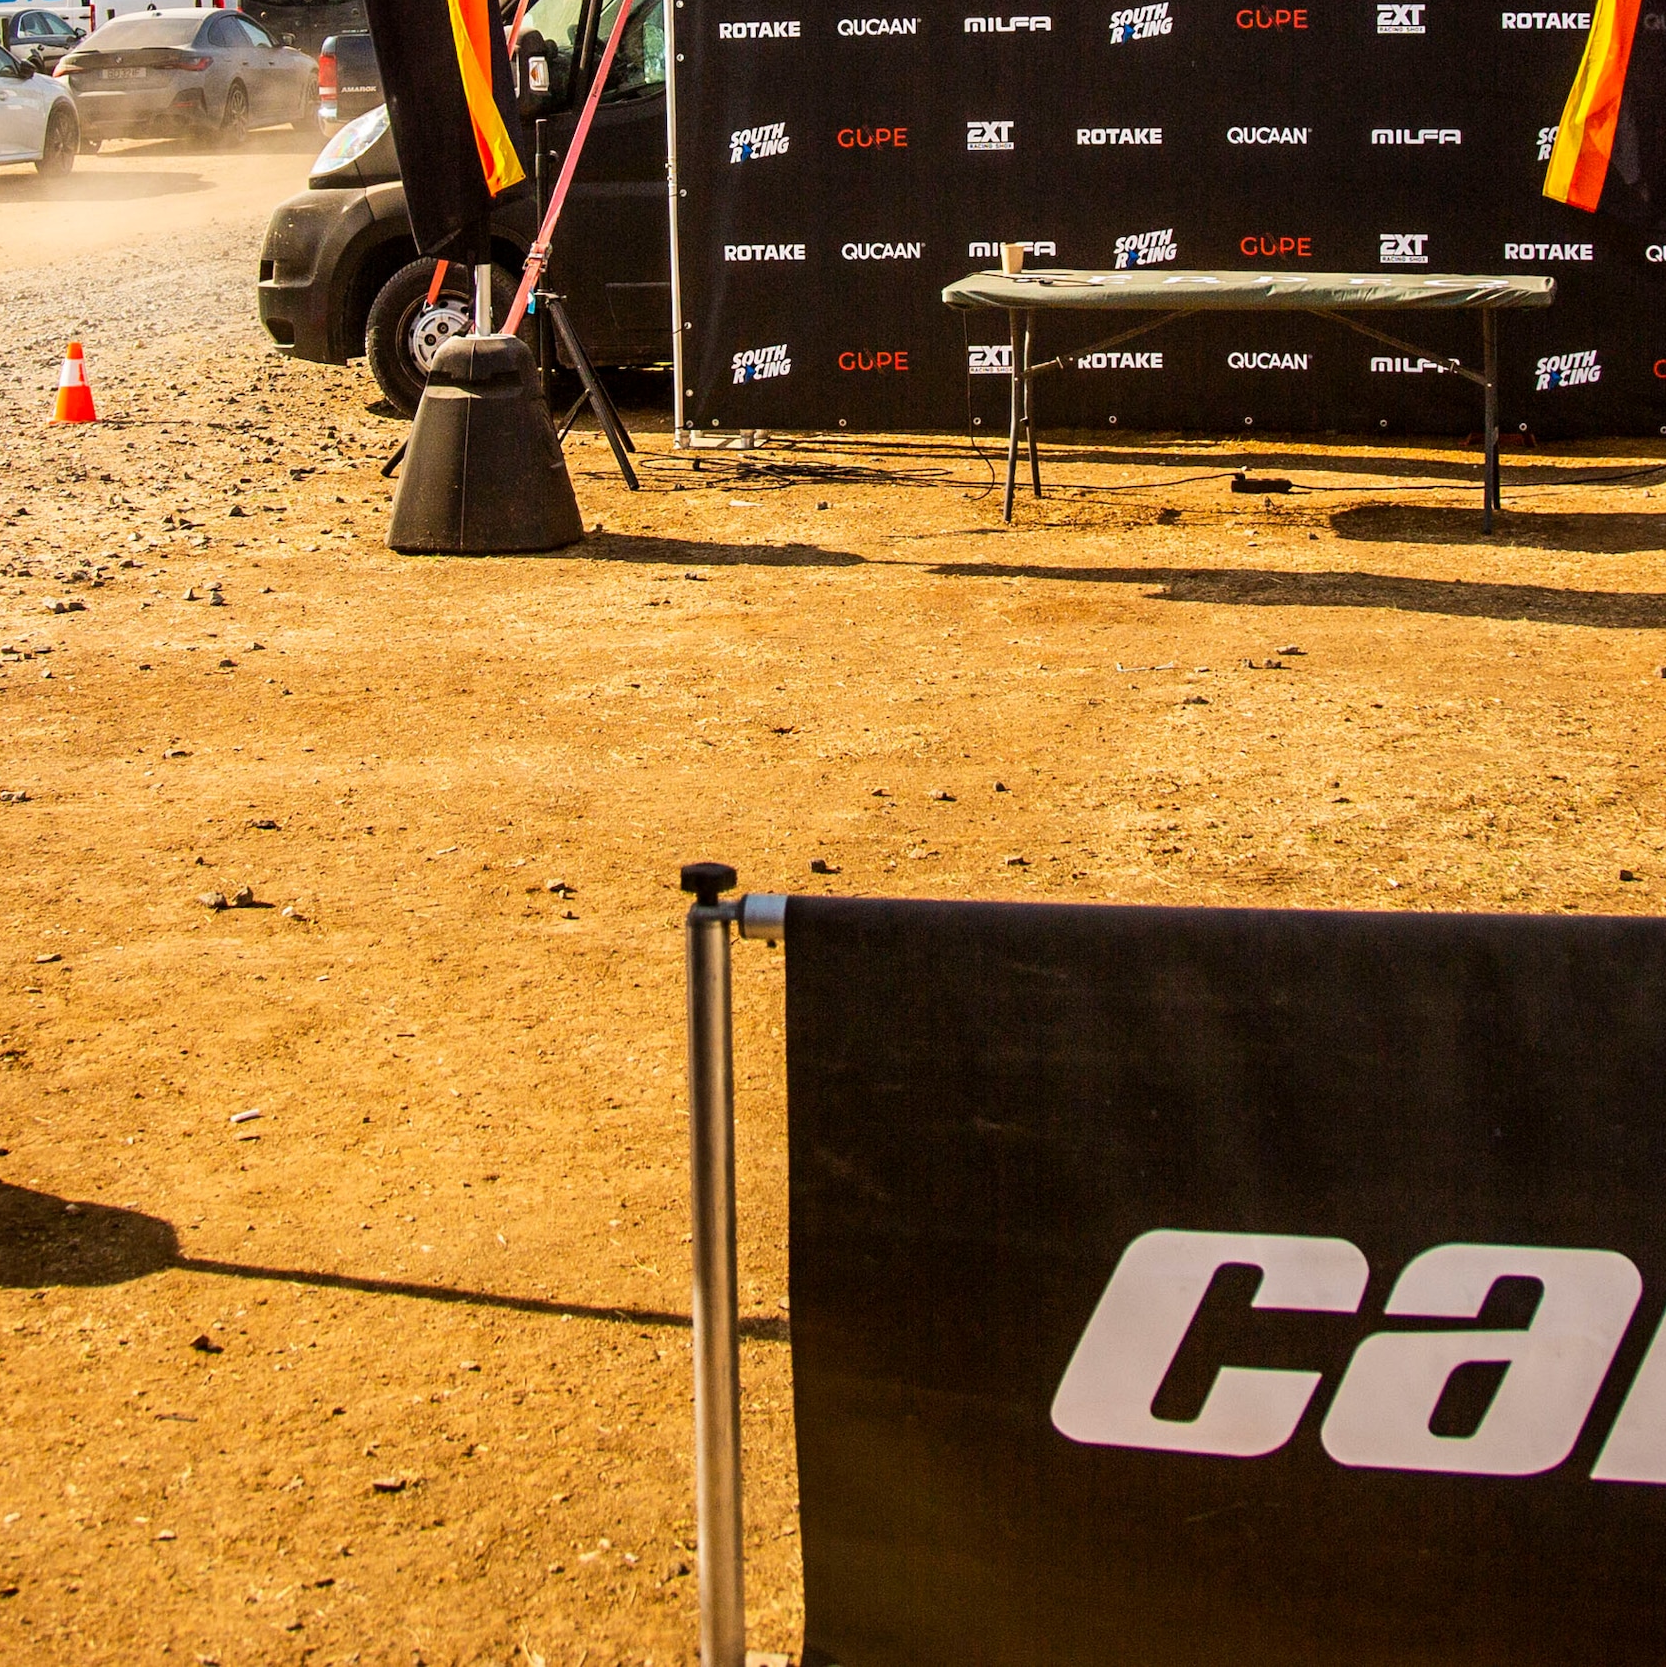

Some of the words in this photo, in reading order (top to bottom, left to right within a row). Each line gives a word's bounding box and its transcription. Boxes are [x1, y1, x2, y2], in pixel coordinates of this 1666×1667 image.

[964, 15, 1052, 33] MILFA
[1108, 1, 1169, 29] SOUTH
[1235, 8, 1309, 30] GUPE
[1501, 12, 1591, 30] ROTAKE
[718, 20, 801, 40] ROTAKE
[728, 121, 786, 148] SOUTH
[836, 127, 909, 149] GUPE
[1076, 127, 1163, 145] ROTAKE
[1371, 128, 1462, 145] MILFA
[968, 241, 1057, 258] MIFA
[1113, 228, 1173, 254] SOUTH
[1239, 236, 1313, 258] GUPE
[723, 243, 806, 262] ROTAKE
[1504, 243, 1593, 261] ROTAKE
[730, 343, 788, 369] SOUTH
[837, 350, 910, 372] GUPE
[1077, 351, 1164, 369] ROTAKE
[1534, 349, 1597, 375] SOUTH
